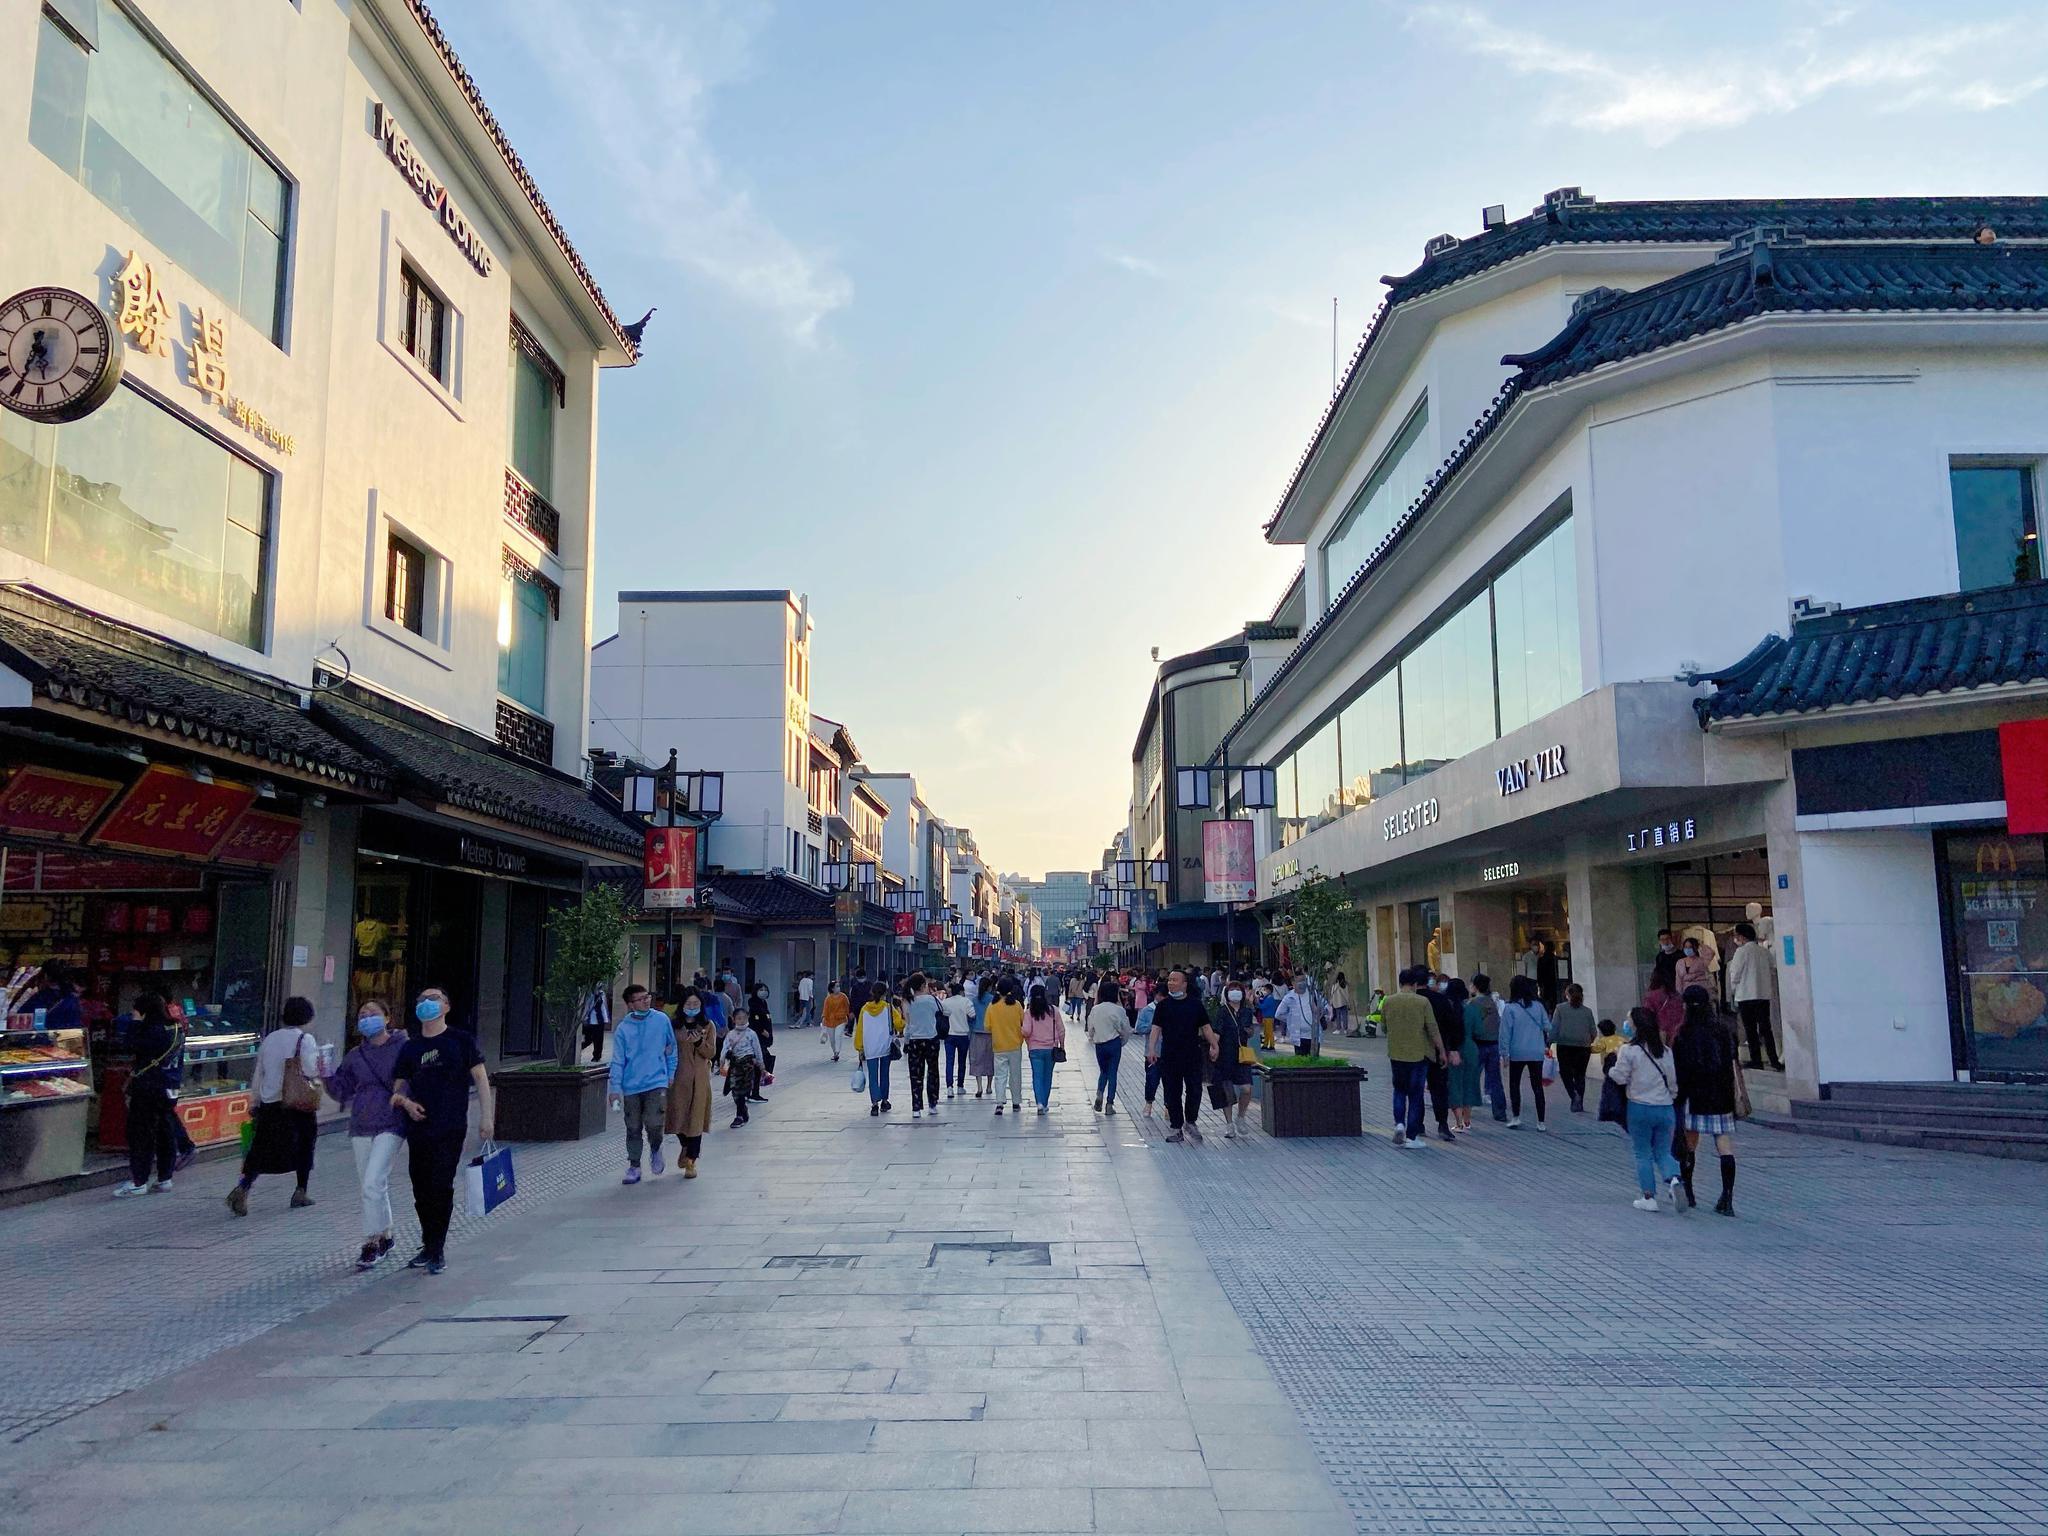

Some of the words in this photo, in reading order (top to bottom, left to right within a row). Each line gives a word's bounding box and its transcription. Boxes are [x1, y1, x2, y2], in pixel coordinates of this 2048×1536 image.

[1382, 796, 1439, 841] SELECTED
[1627, 818, 1696, 853] 工厂直销店
[461, 837, 493, 866] Meters
[496, 846, 526, 873] bonwe
[1483, 862, 1519, 881] SELECTED
